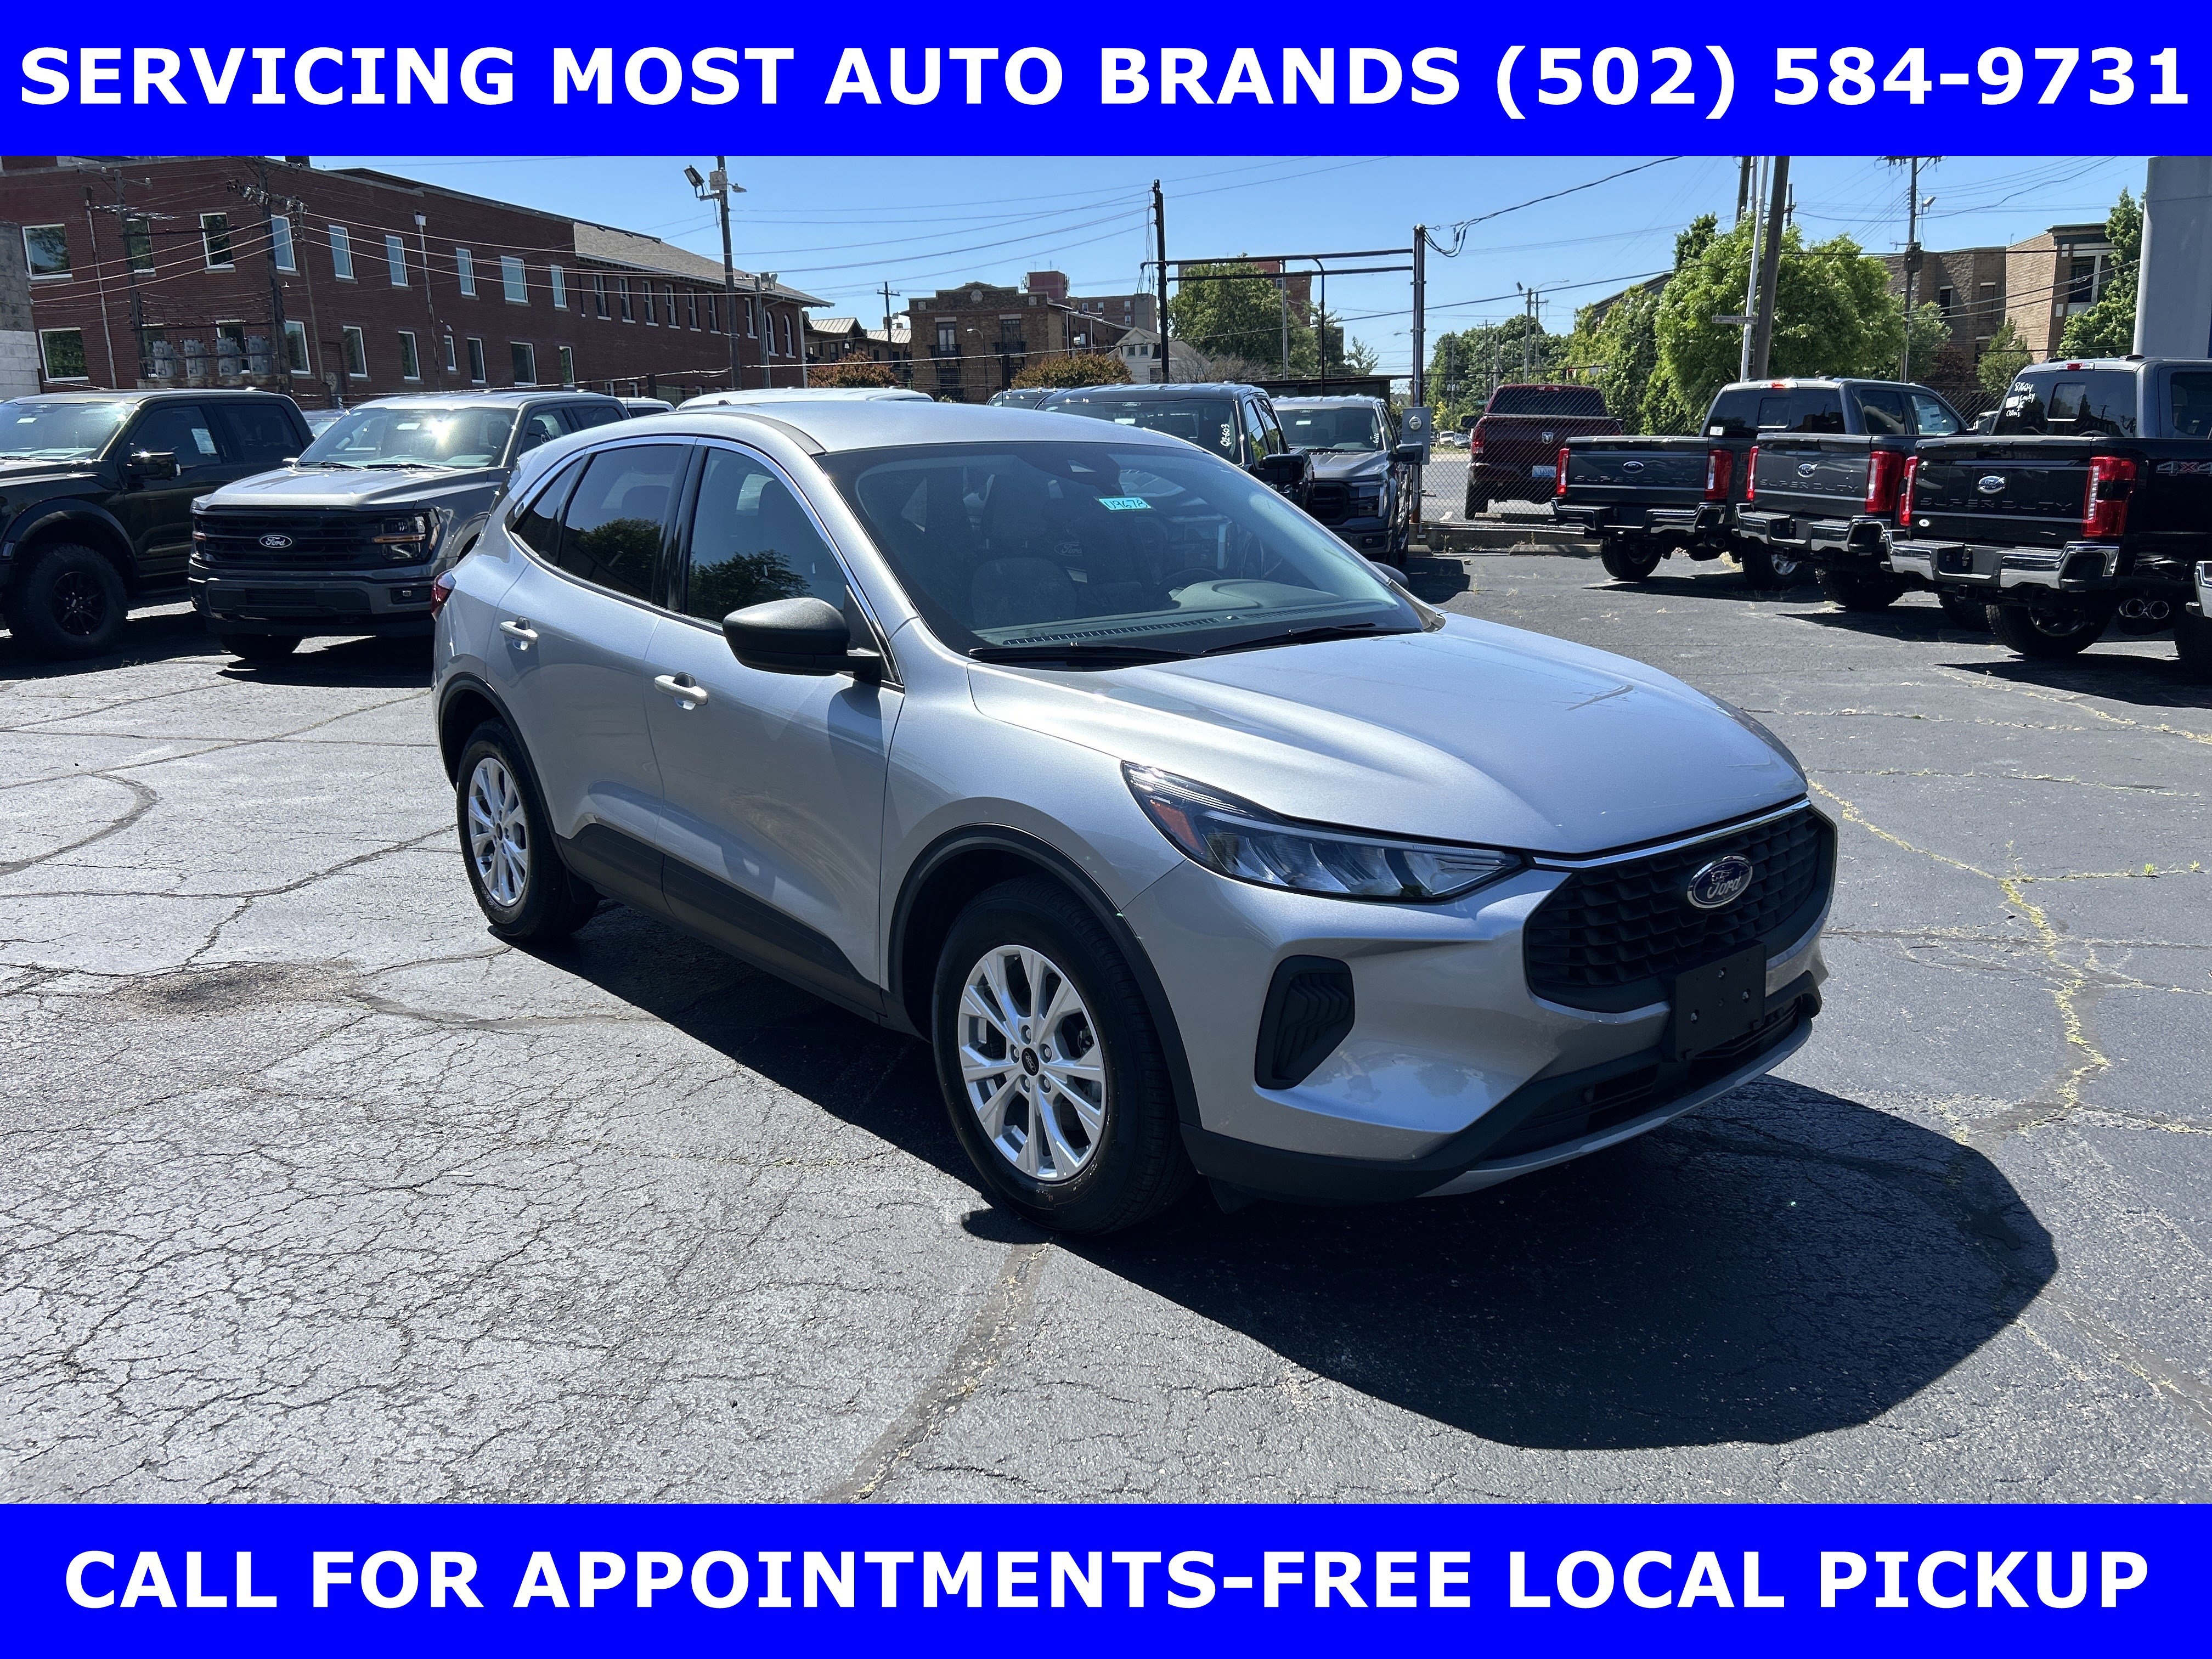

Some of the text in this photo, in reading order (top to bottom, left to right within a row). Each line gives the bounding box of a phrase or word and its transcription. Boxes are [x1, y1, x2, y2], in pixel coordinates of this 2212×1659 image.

[1759, 479, 1859, 492] SUPER DUTY
[1920, 498, 2073, 511] SUPER DUTY
[266, 537, 286, 546] Ford
[1707, 867, 1742, 899] Ford
